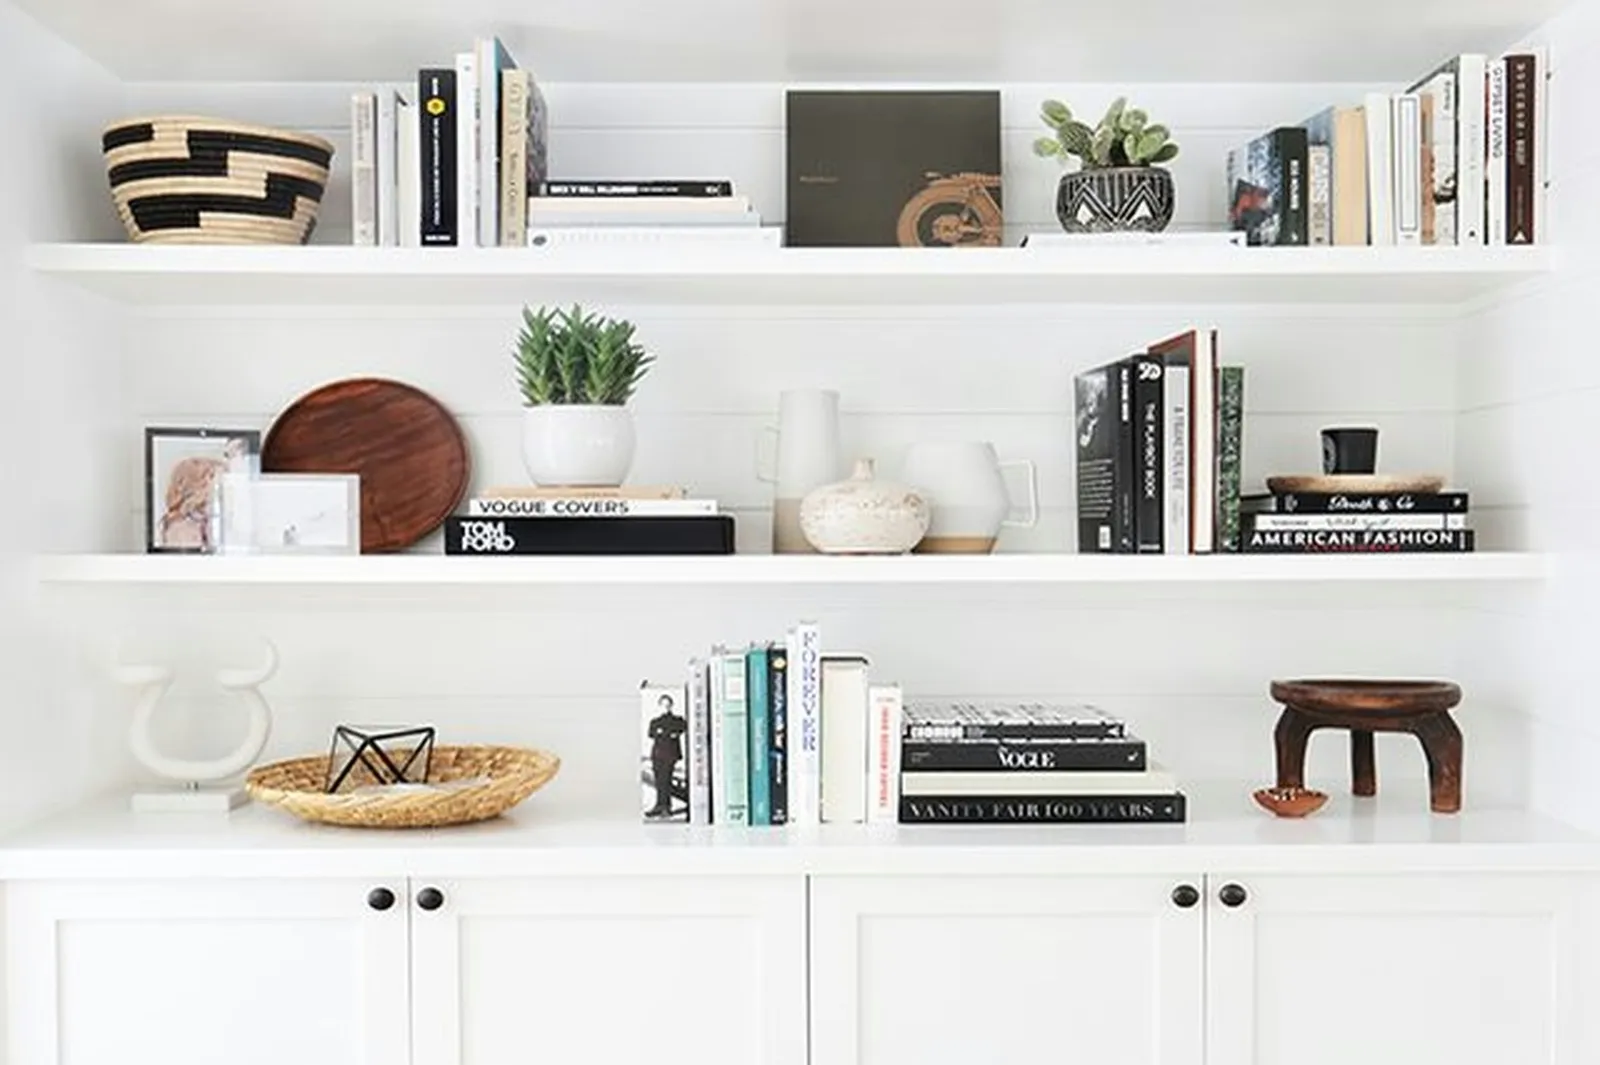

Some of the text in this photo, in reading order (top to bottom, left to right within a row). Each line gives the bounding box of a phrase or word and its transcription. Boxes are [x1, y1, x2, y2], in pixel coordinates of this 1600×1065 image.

[1492, 117, 1503, 159] LIVING
[1144, 403, 1156, 498] THE PLAYBOY BOOK
[478, 500, 630, 513] VOGUE COVERS
[460, 521, 505, 537] TOM
[462, 535, 515, 551] FORD
[1251, 531, 1454, 545] AMERICAN FASHION
[998, 747, 1056, 768] VOGUE
[910, 803, 991, 819] VANITY
[993, 803, 1041, 818] FAIR
[1089, 803, 1155, 818] YEARS
